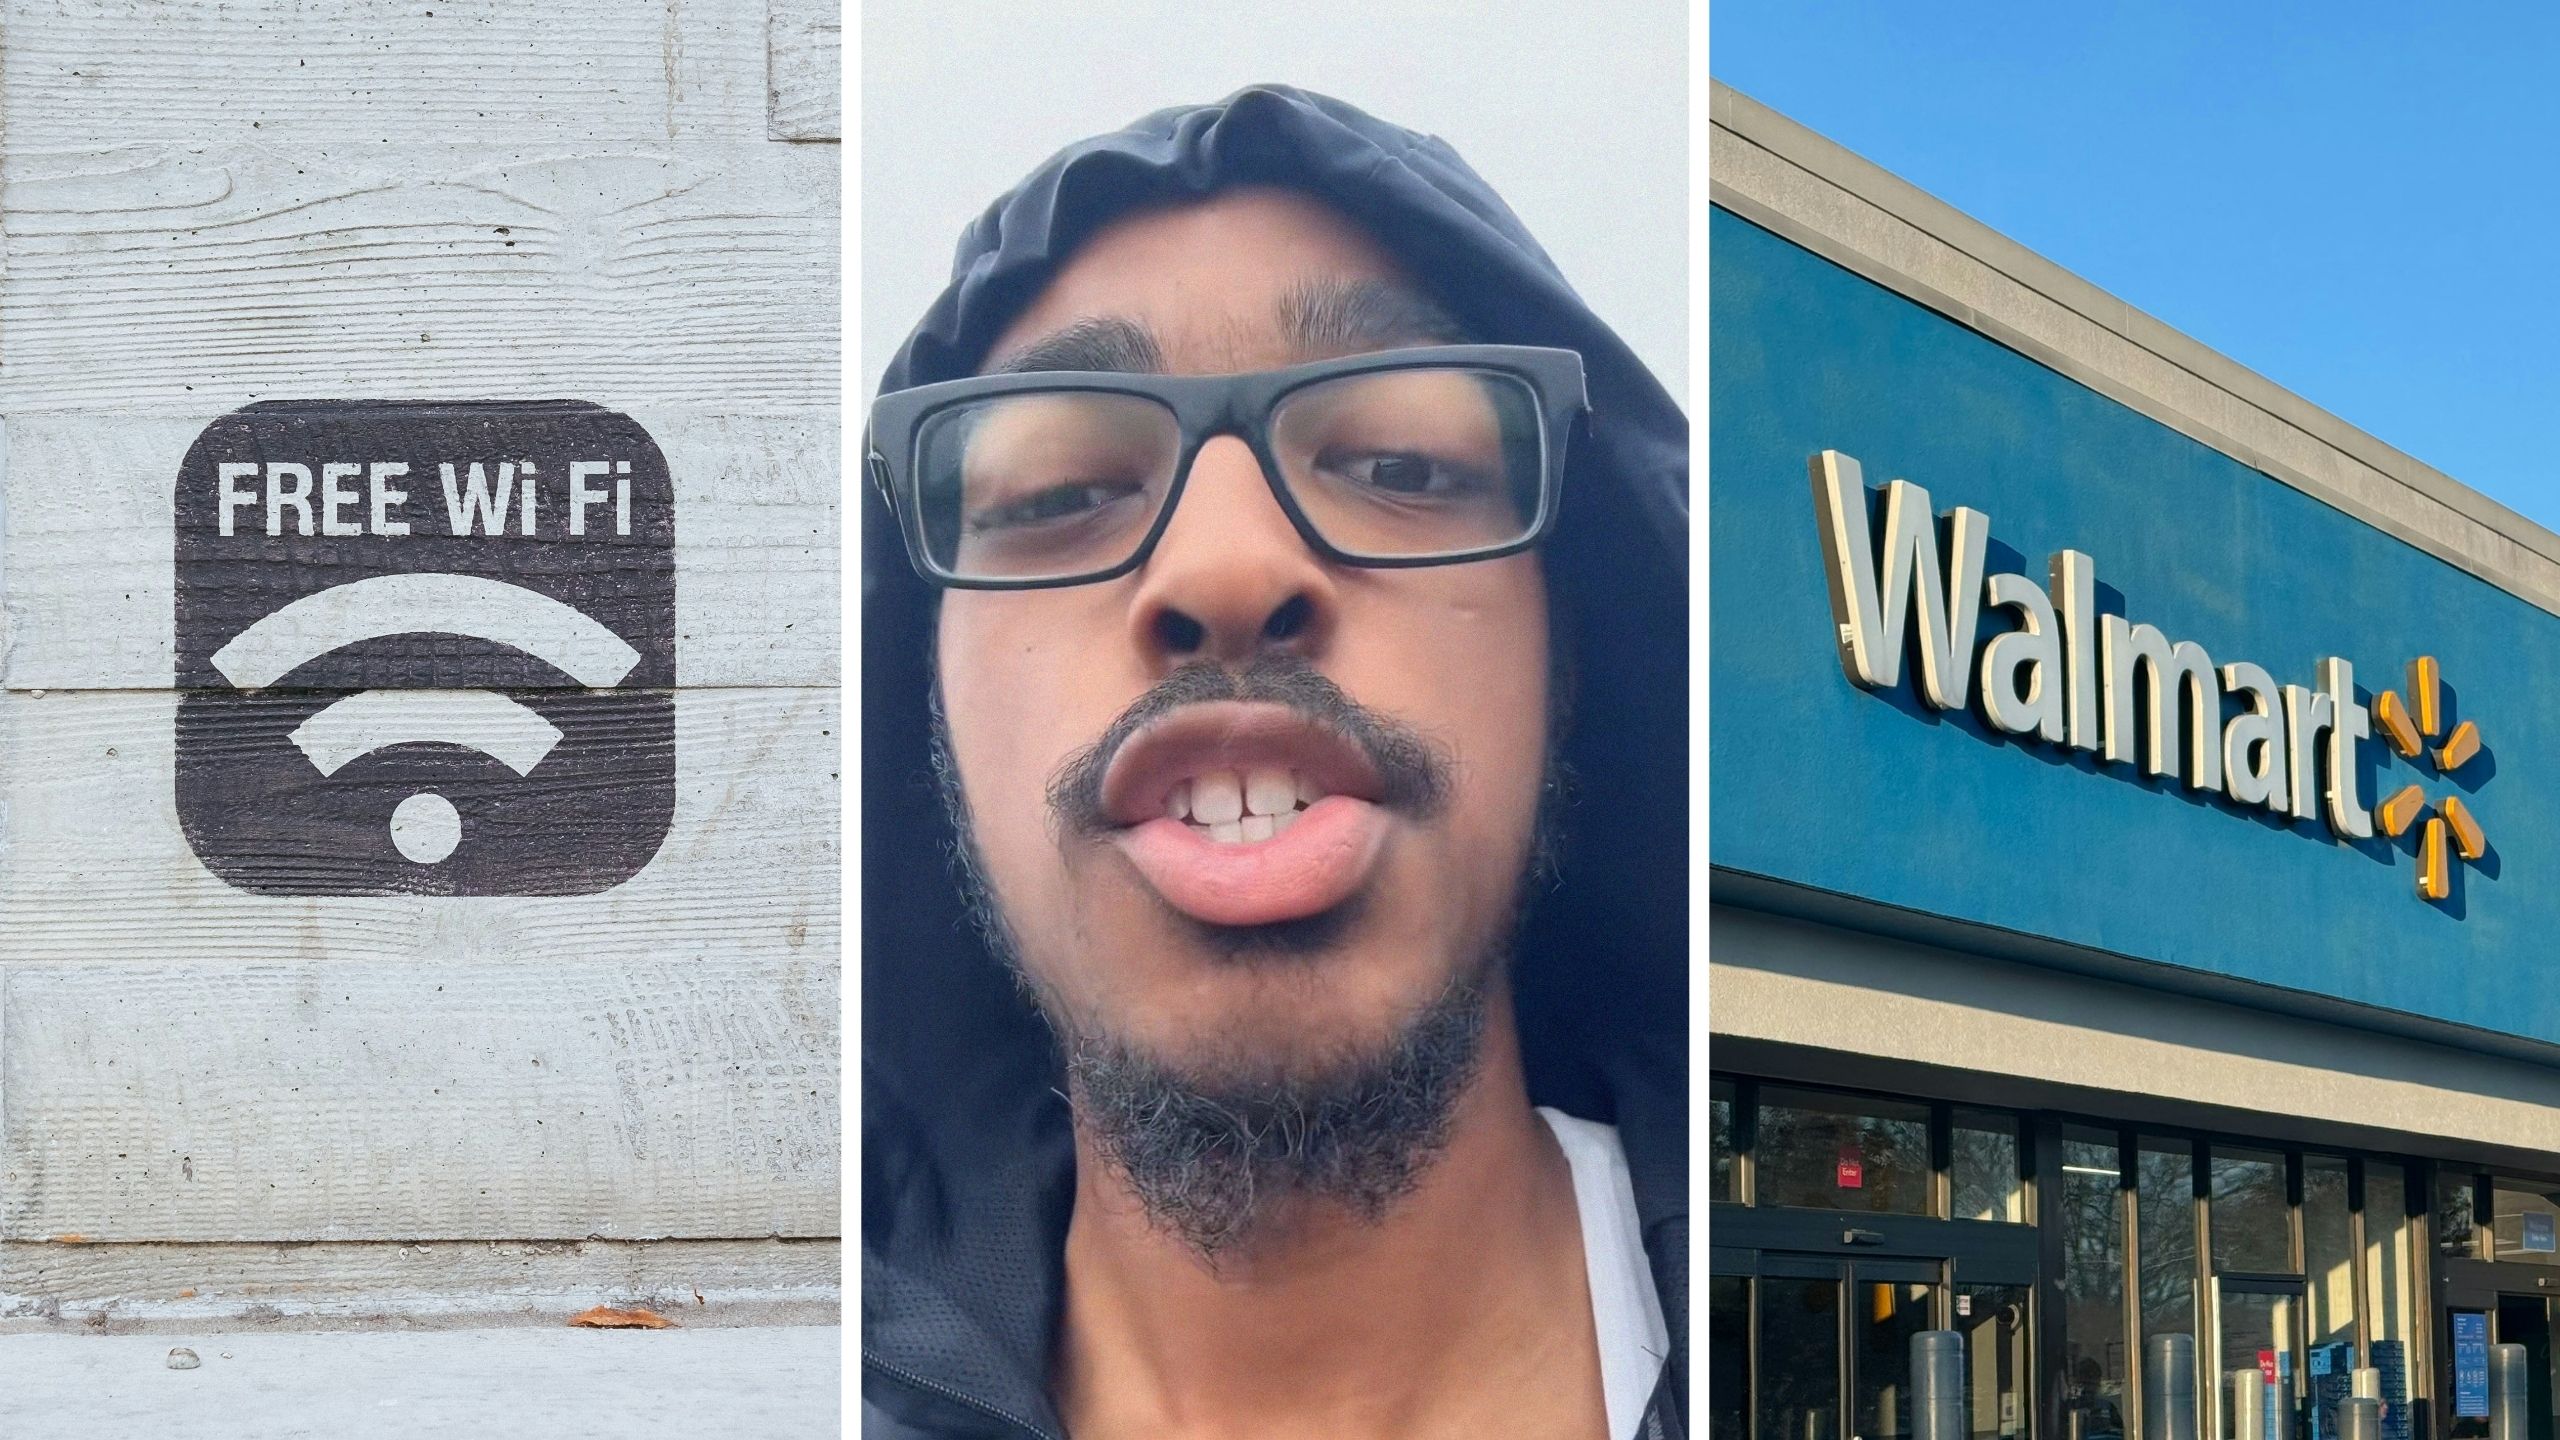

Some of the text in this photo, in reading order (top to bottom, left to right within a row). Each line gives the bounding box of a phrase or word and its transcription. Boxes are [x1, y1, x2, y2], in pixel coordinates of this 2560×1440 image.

[219, 460, 631, 536] FREE Wi Fi
[1809, 449, 2372, 838] Walmart
